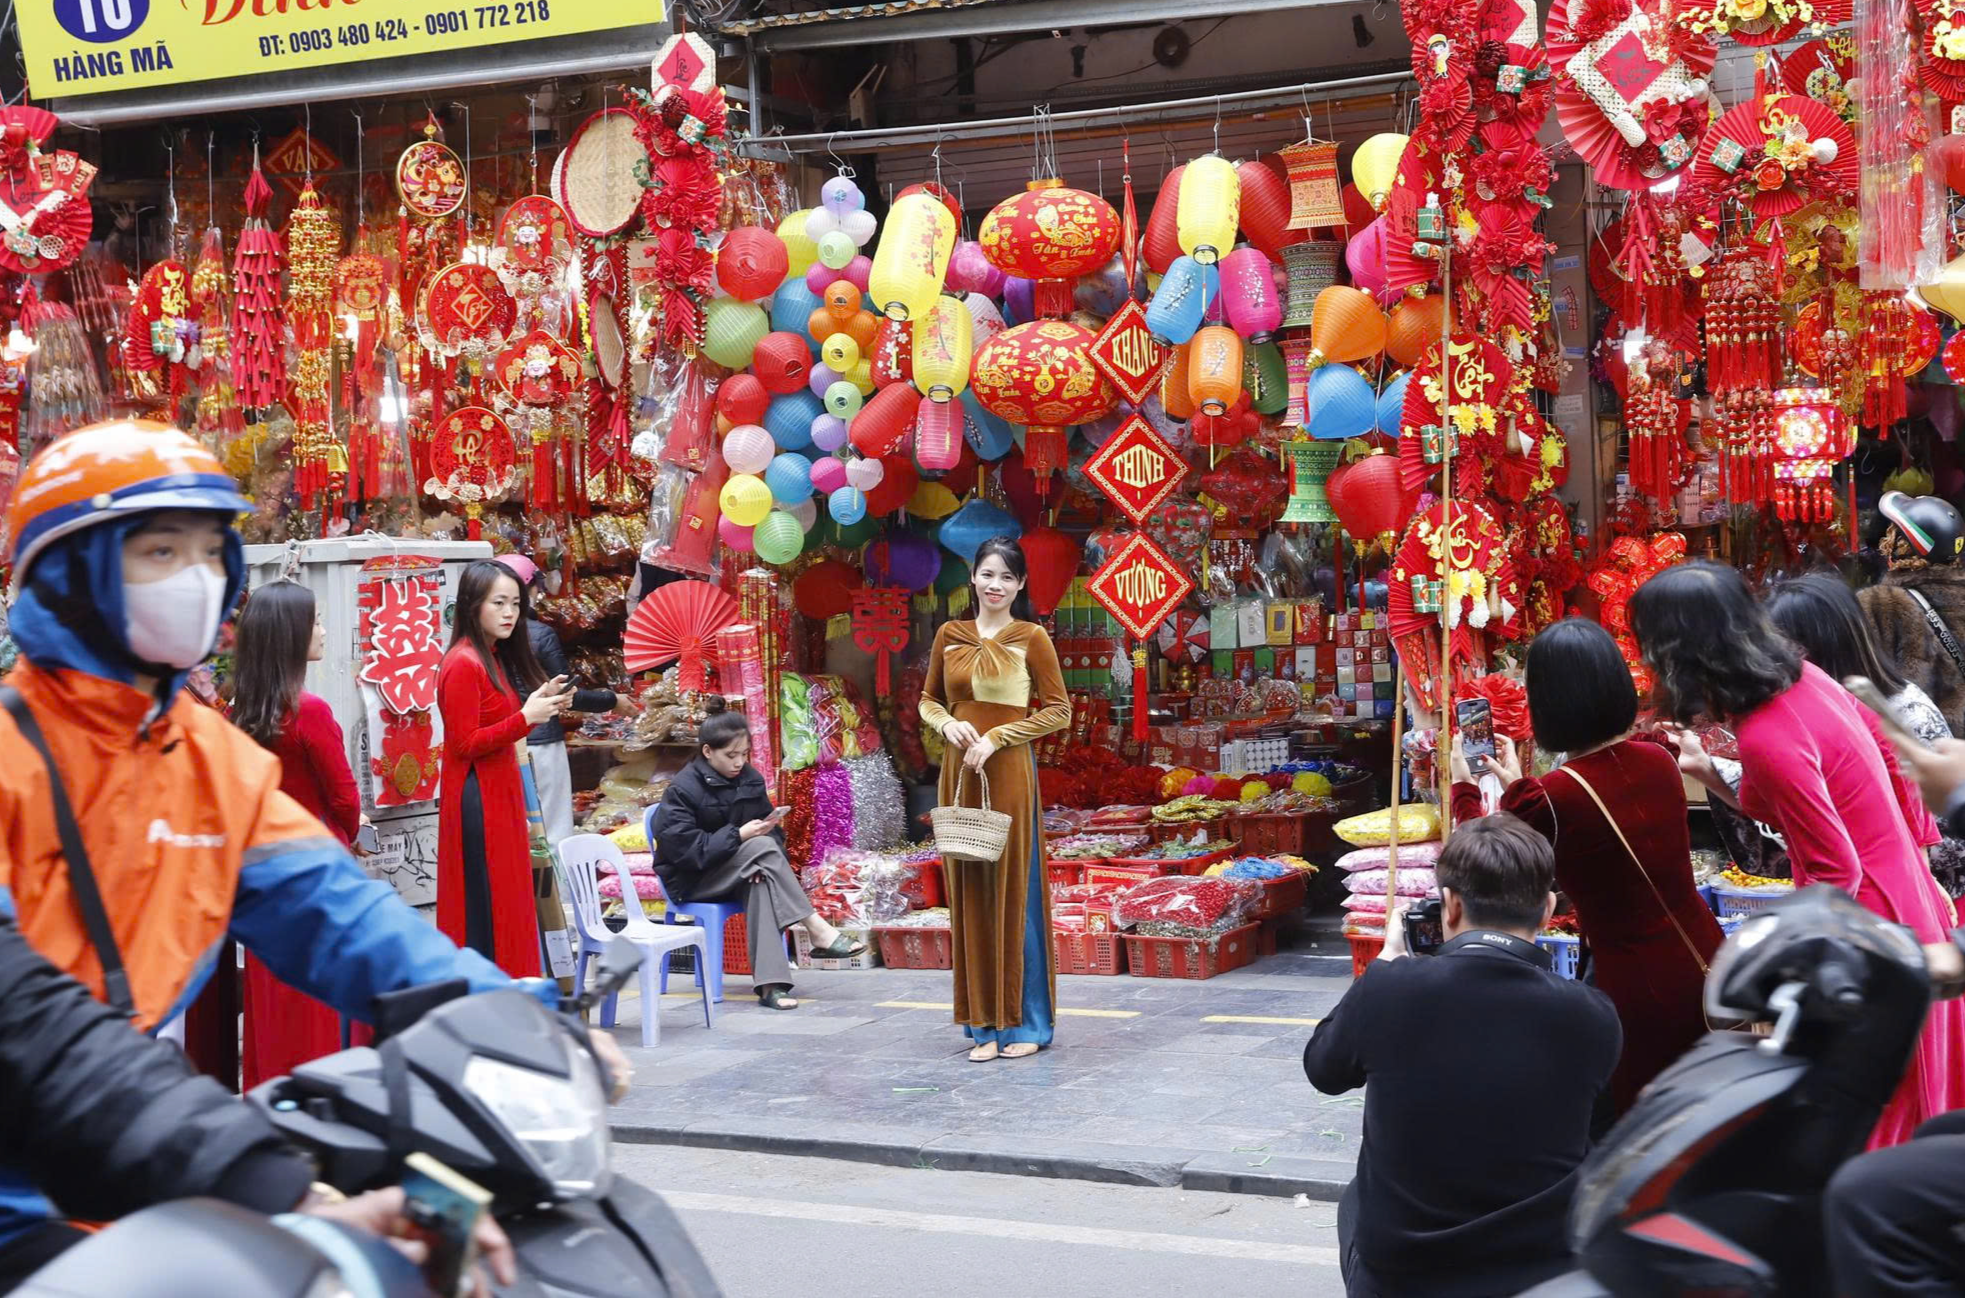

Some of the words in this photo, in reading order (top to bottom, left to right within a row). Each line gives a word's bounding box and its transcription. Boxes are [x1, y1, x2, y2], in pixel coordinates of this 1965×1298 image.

[258, 34, 286, 57] ĐT:
[288, 28, 333, 54] 0903
[338, 23, 370, 47] 480
[375, 18, 408, 42] 424
[425, 9, 468, 36] 0901
[474, 4, 510, 29] 772
[516, 0, 550, 24] 218
[53, 50, 124, 83] HÀNG
[130, 40, 174, 74] MÃ
[1112, 324, 1159, 378] KHANG
[1114, 557, 1167, 618] VƯỢNG
[1482, 933, 1513, 946] SONY
